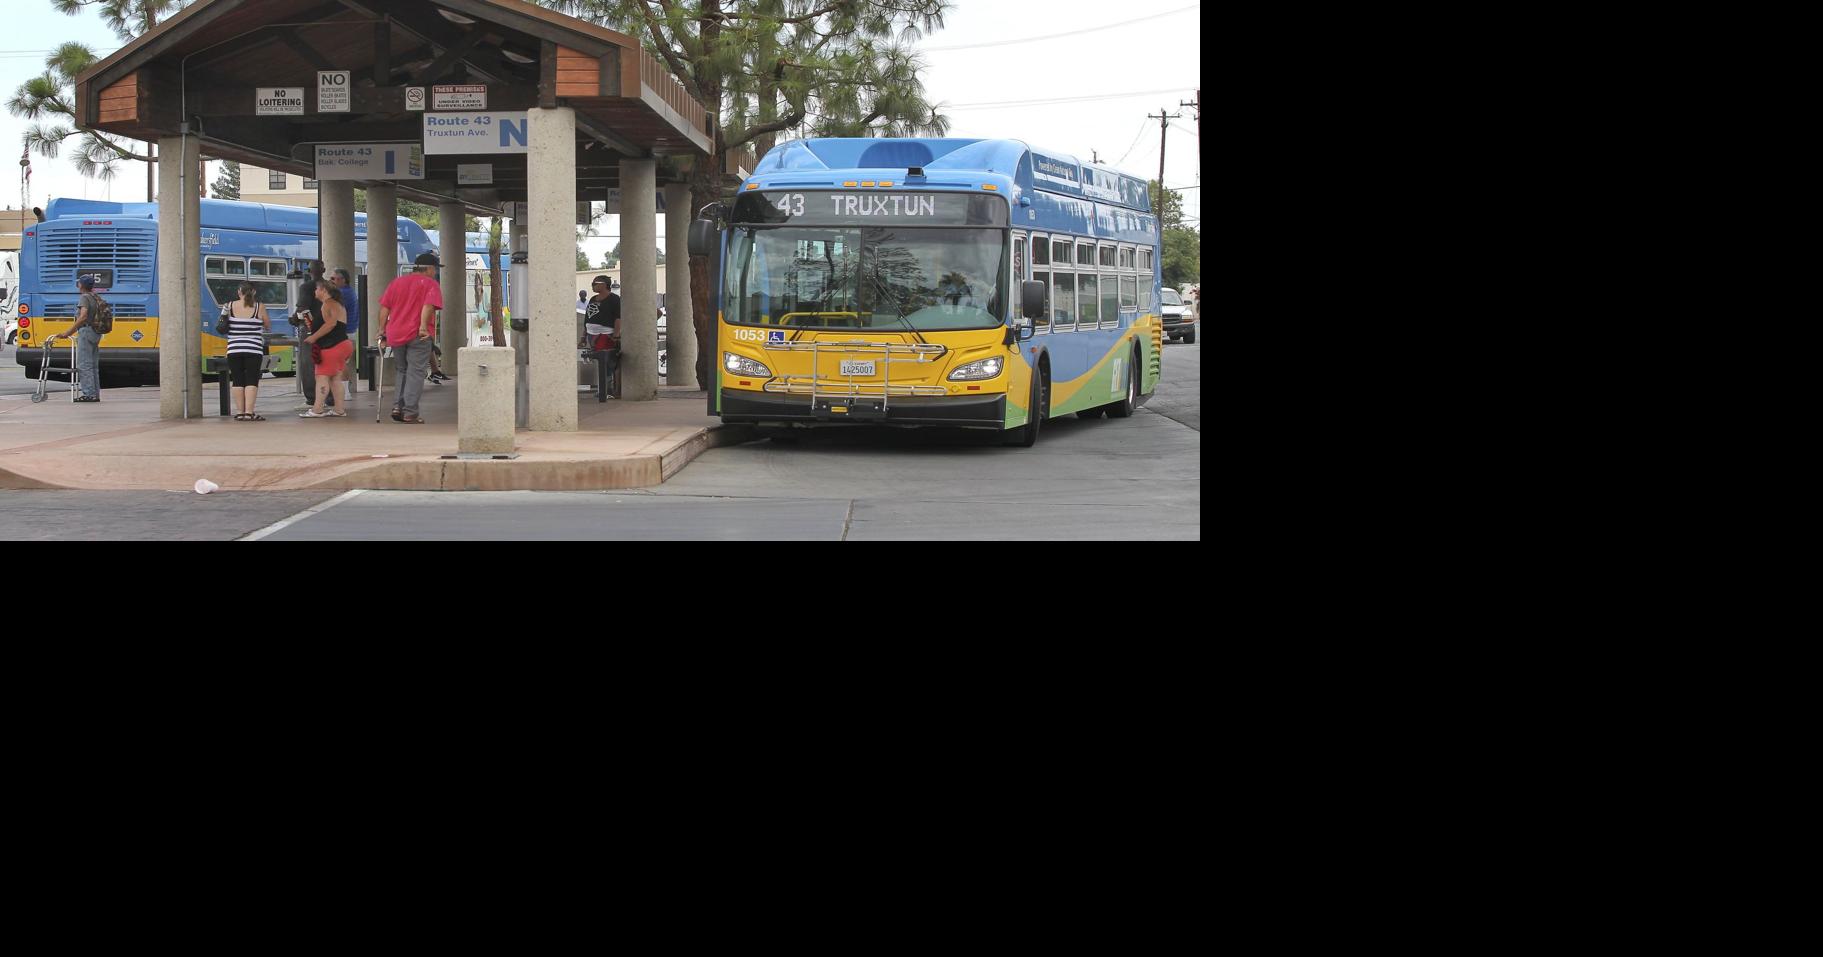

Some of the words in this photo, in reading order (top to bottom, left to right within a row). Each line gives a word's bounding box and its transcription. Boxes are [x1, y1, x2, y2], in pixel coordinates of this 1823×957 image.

[321, 74, 346, 85] NO
[259, 98, 302, 106] LOITERING
[427, 116, 469, 126] Route
[473, 116, 491, 125] 43
[427, 129, 465, 137] Truxtun
[467, 129, 489, 137] Ave.
[499, 119, 528, 147] N
[318, 148, 354, 156] Route
[357, 147, 372, 156] 43
[337, 158, 369, 167] College
[776, 193, 805, 217] 43
[830, 195, 935, 217] TRUXTUN
[734, 328, 766, 341] 1053
[842, 365, 873, 374] 1425007
